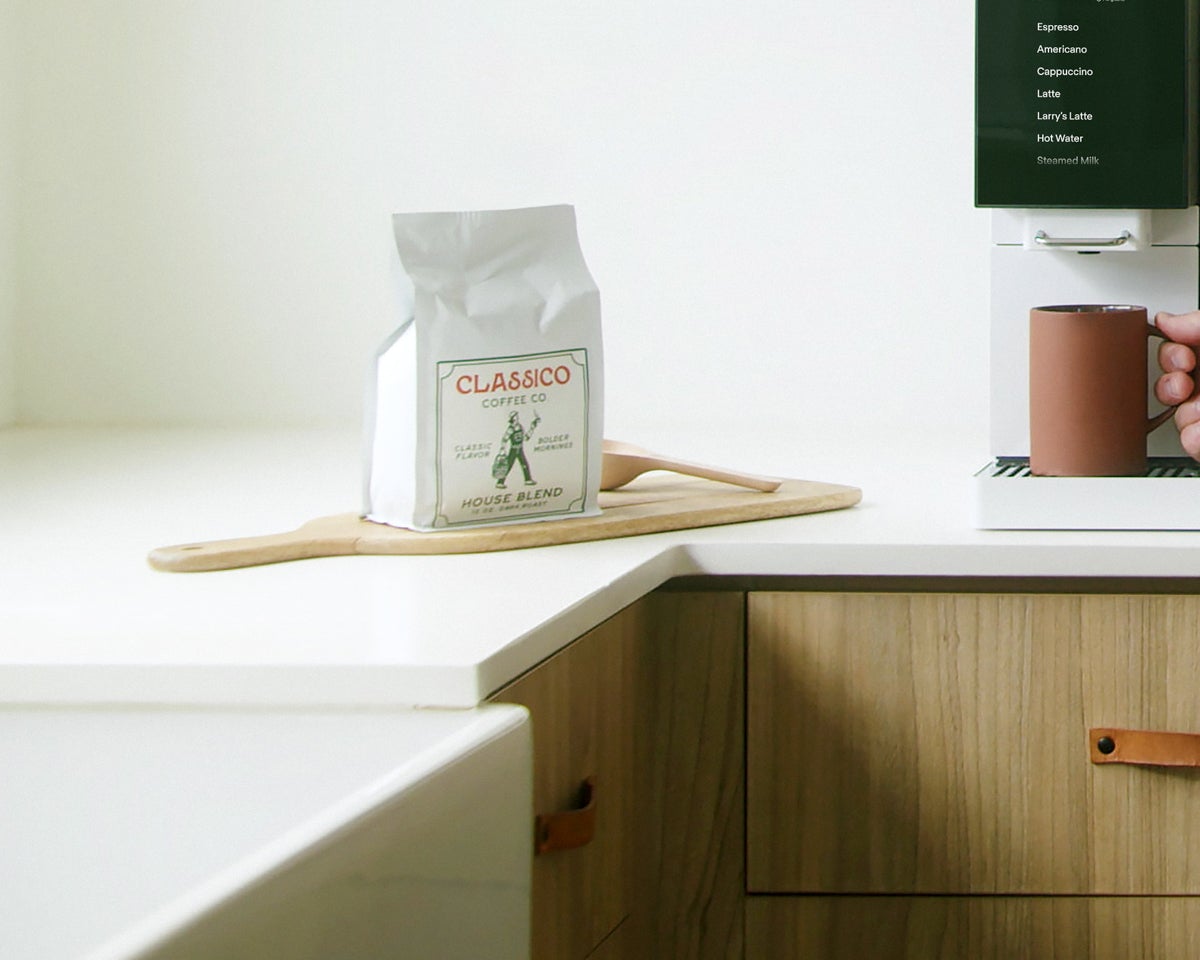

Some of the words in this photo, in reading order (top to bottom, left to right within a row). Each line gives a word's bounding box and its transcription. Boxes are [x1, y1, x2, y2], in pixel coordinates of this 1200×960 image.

[1037, 21, 1079, 33] Espresso
[1037, 44, 1088, 54] Americano
[1037, 66, 1094, 78] Cappuccino
[1037, 88, 1061, 99] Latte
[1037, 110, 1068, 123] Larry's
[1068, 110, 1094, 121] Latte
[1037, 133, 1054, 144] Hot
[1055, 133, 1084, 144] Water
[1037, 155, 1079, 166] Steamed
[1080, 155, 1100, 166] Milk
[456, 365, 571, 394] CLASSICO
[482, 395, 527, 408] COFFEE
[531, 392, 547, 403] CO
[538, 434, 570, 444] BOLDER
[454, 442, 493, 452] CLASSIC
[456, 451, 490, 460] FLAVOR
[461, 493, 512, 509] HOUSE
[516, 487, 563, 502] BLEND
